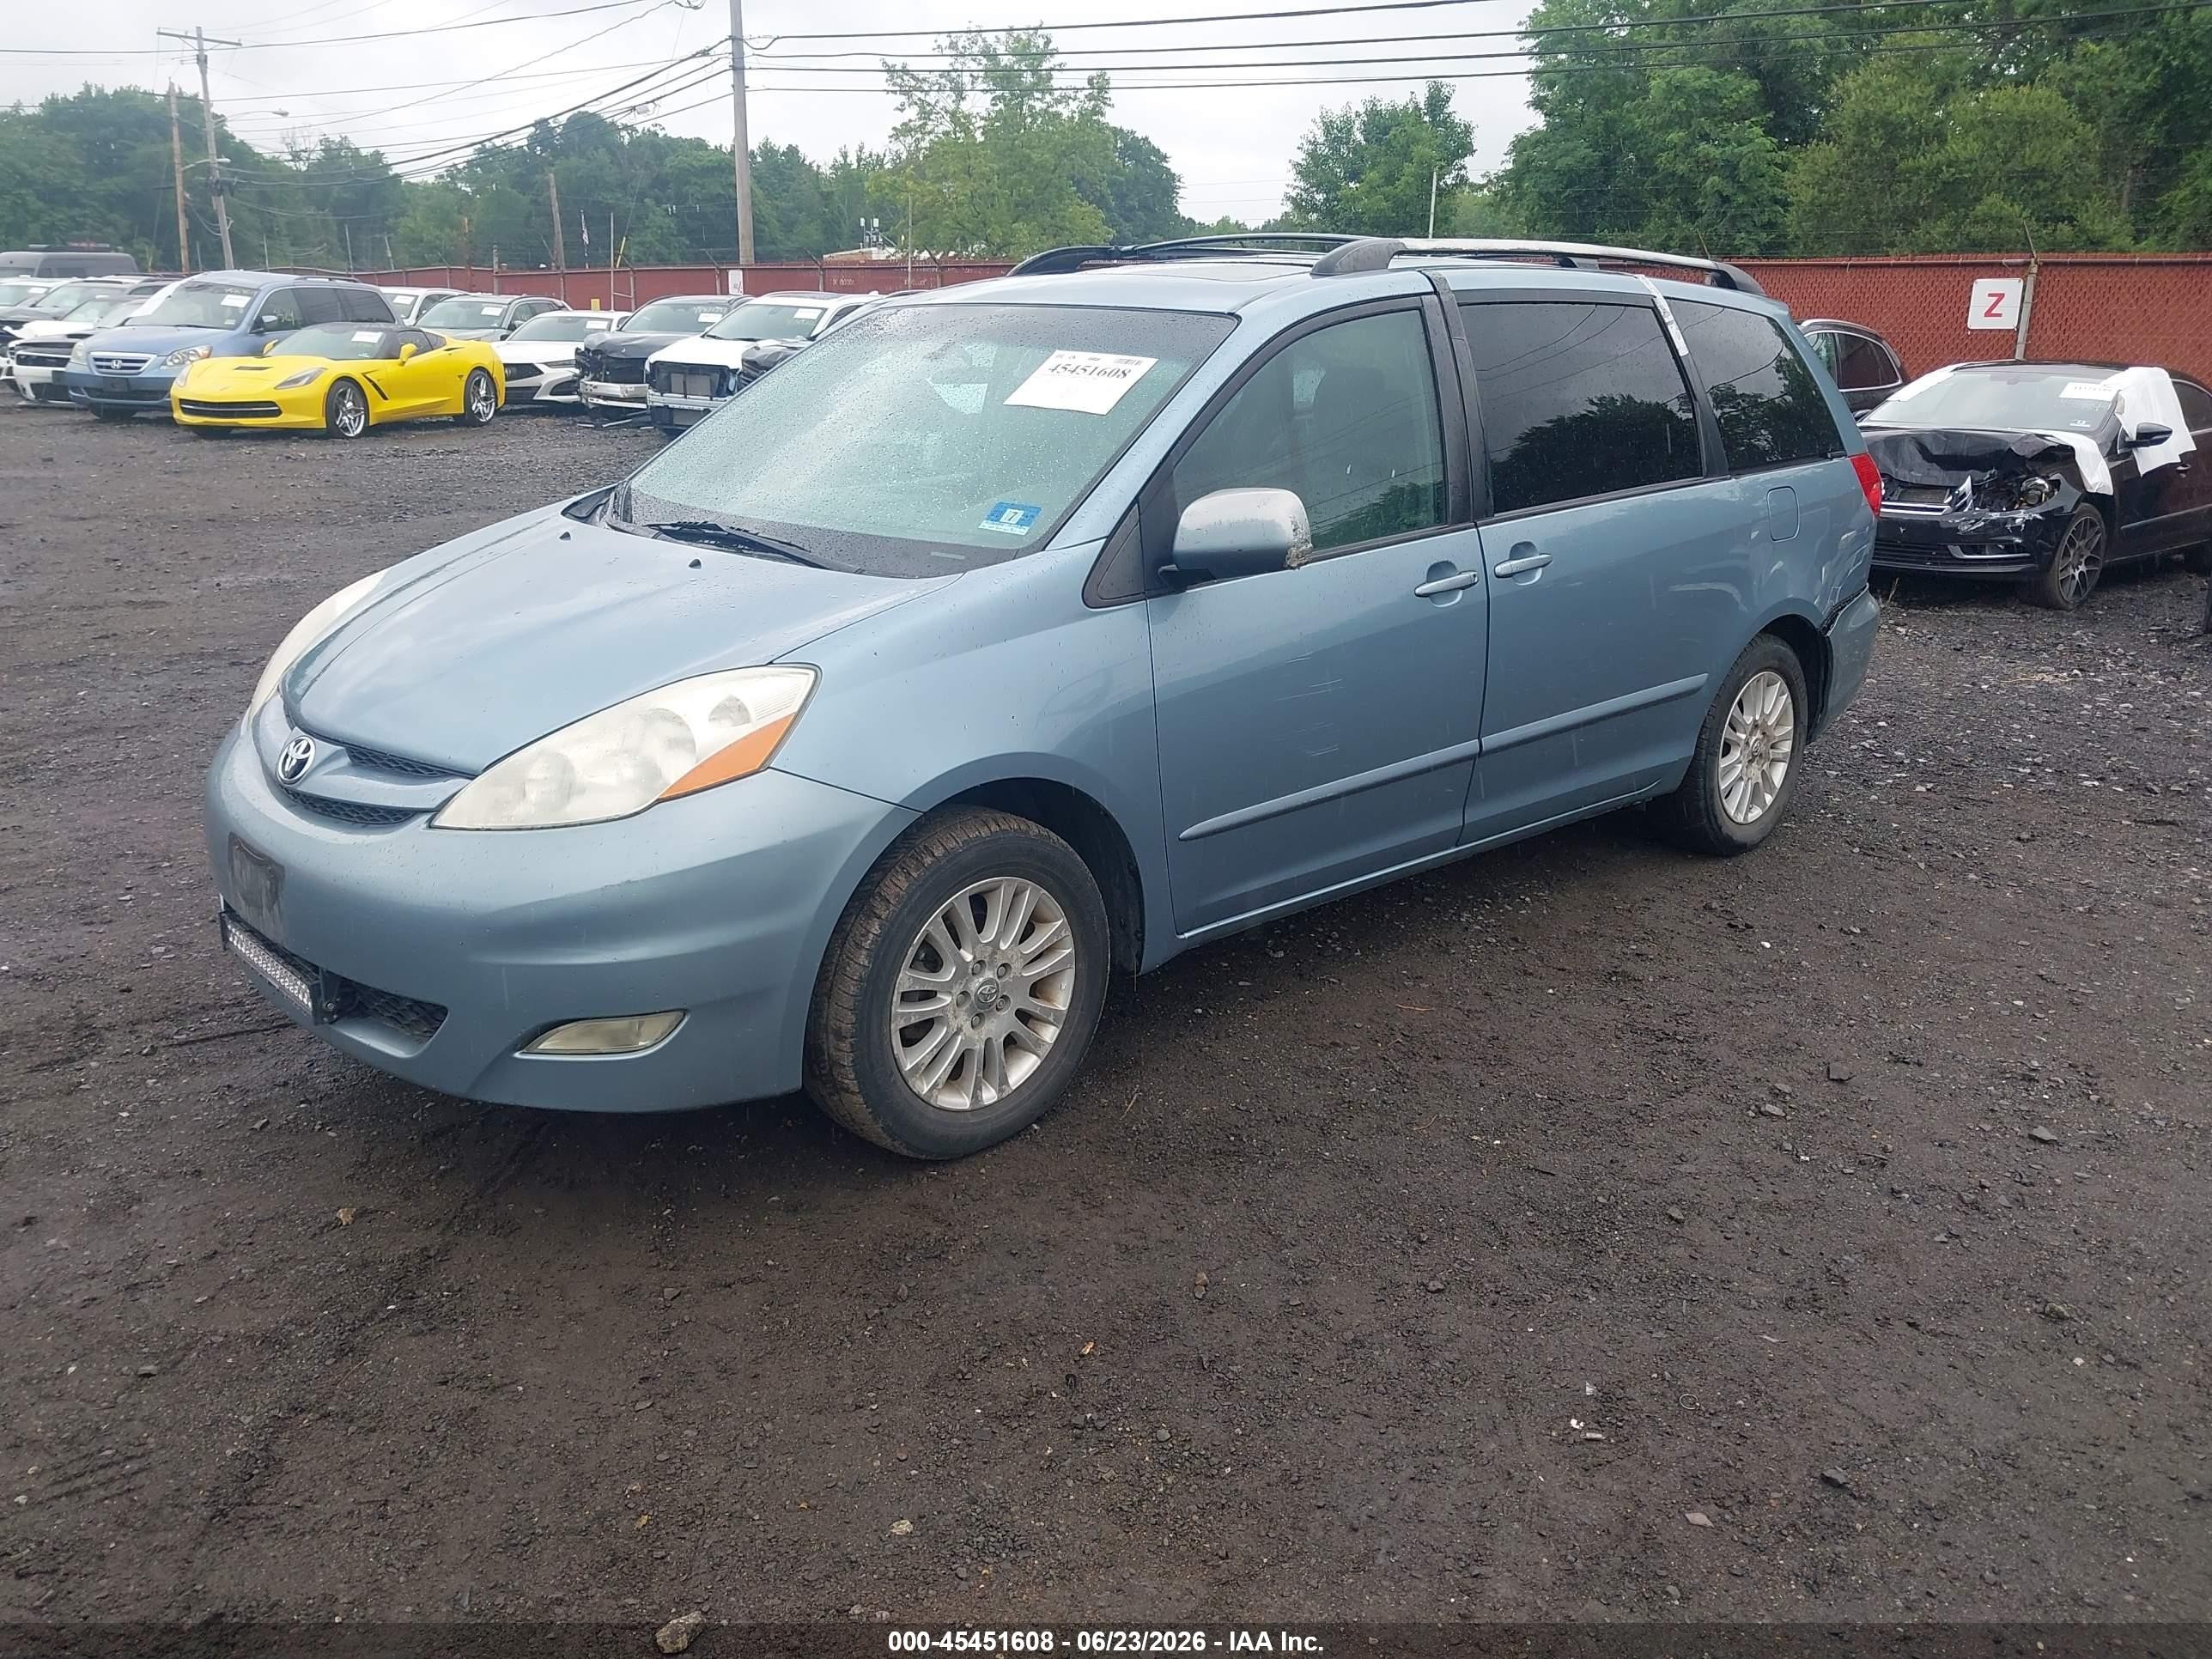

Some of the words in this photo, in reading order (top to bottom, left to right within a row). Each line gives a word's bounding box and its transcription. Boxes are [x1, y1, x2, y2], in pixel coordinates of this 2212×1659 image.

[1984, 293, 2006, 318] Z
[1048, 363, 1132, 379] 45451608
[1007, 511, 1018, 522] 7
